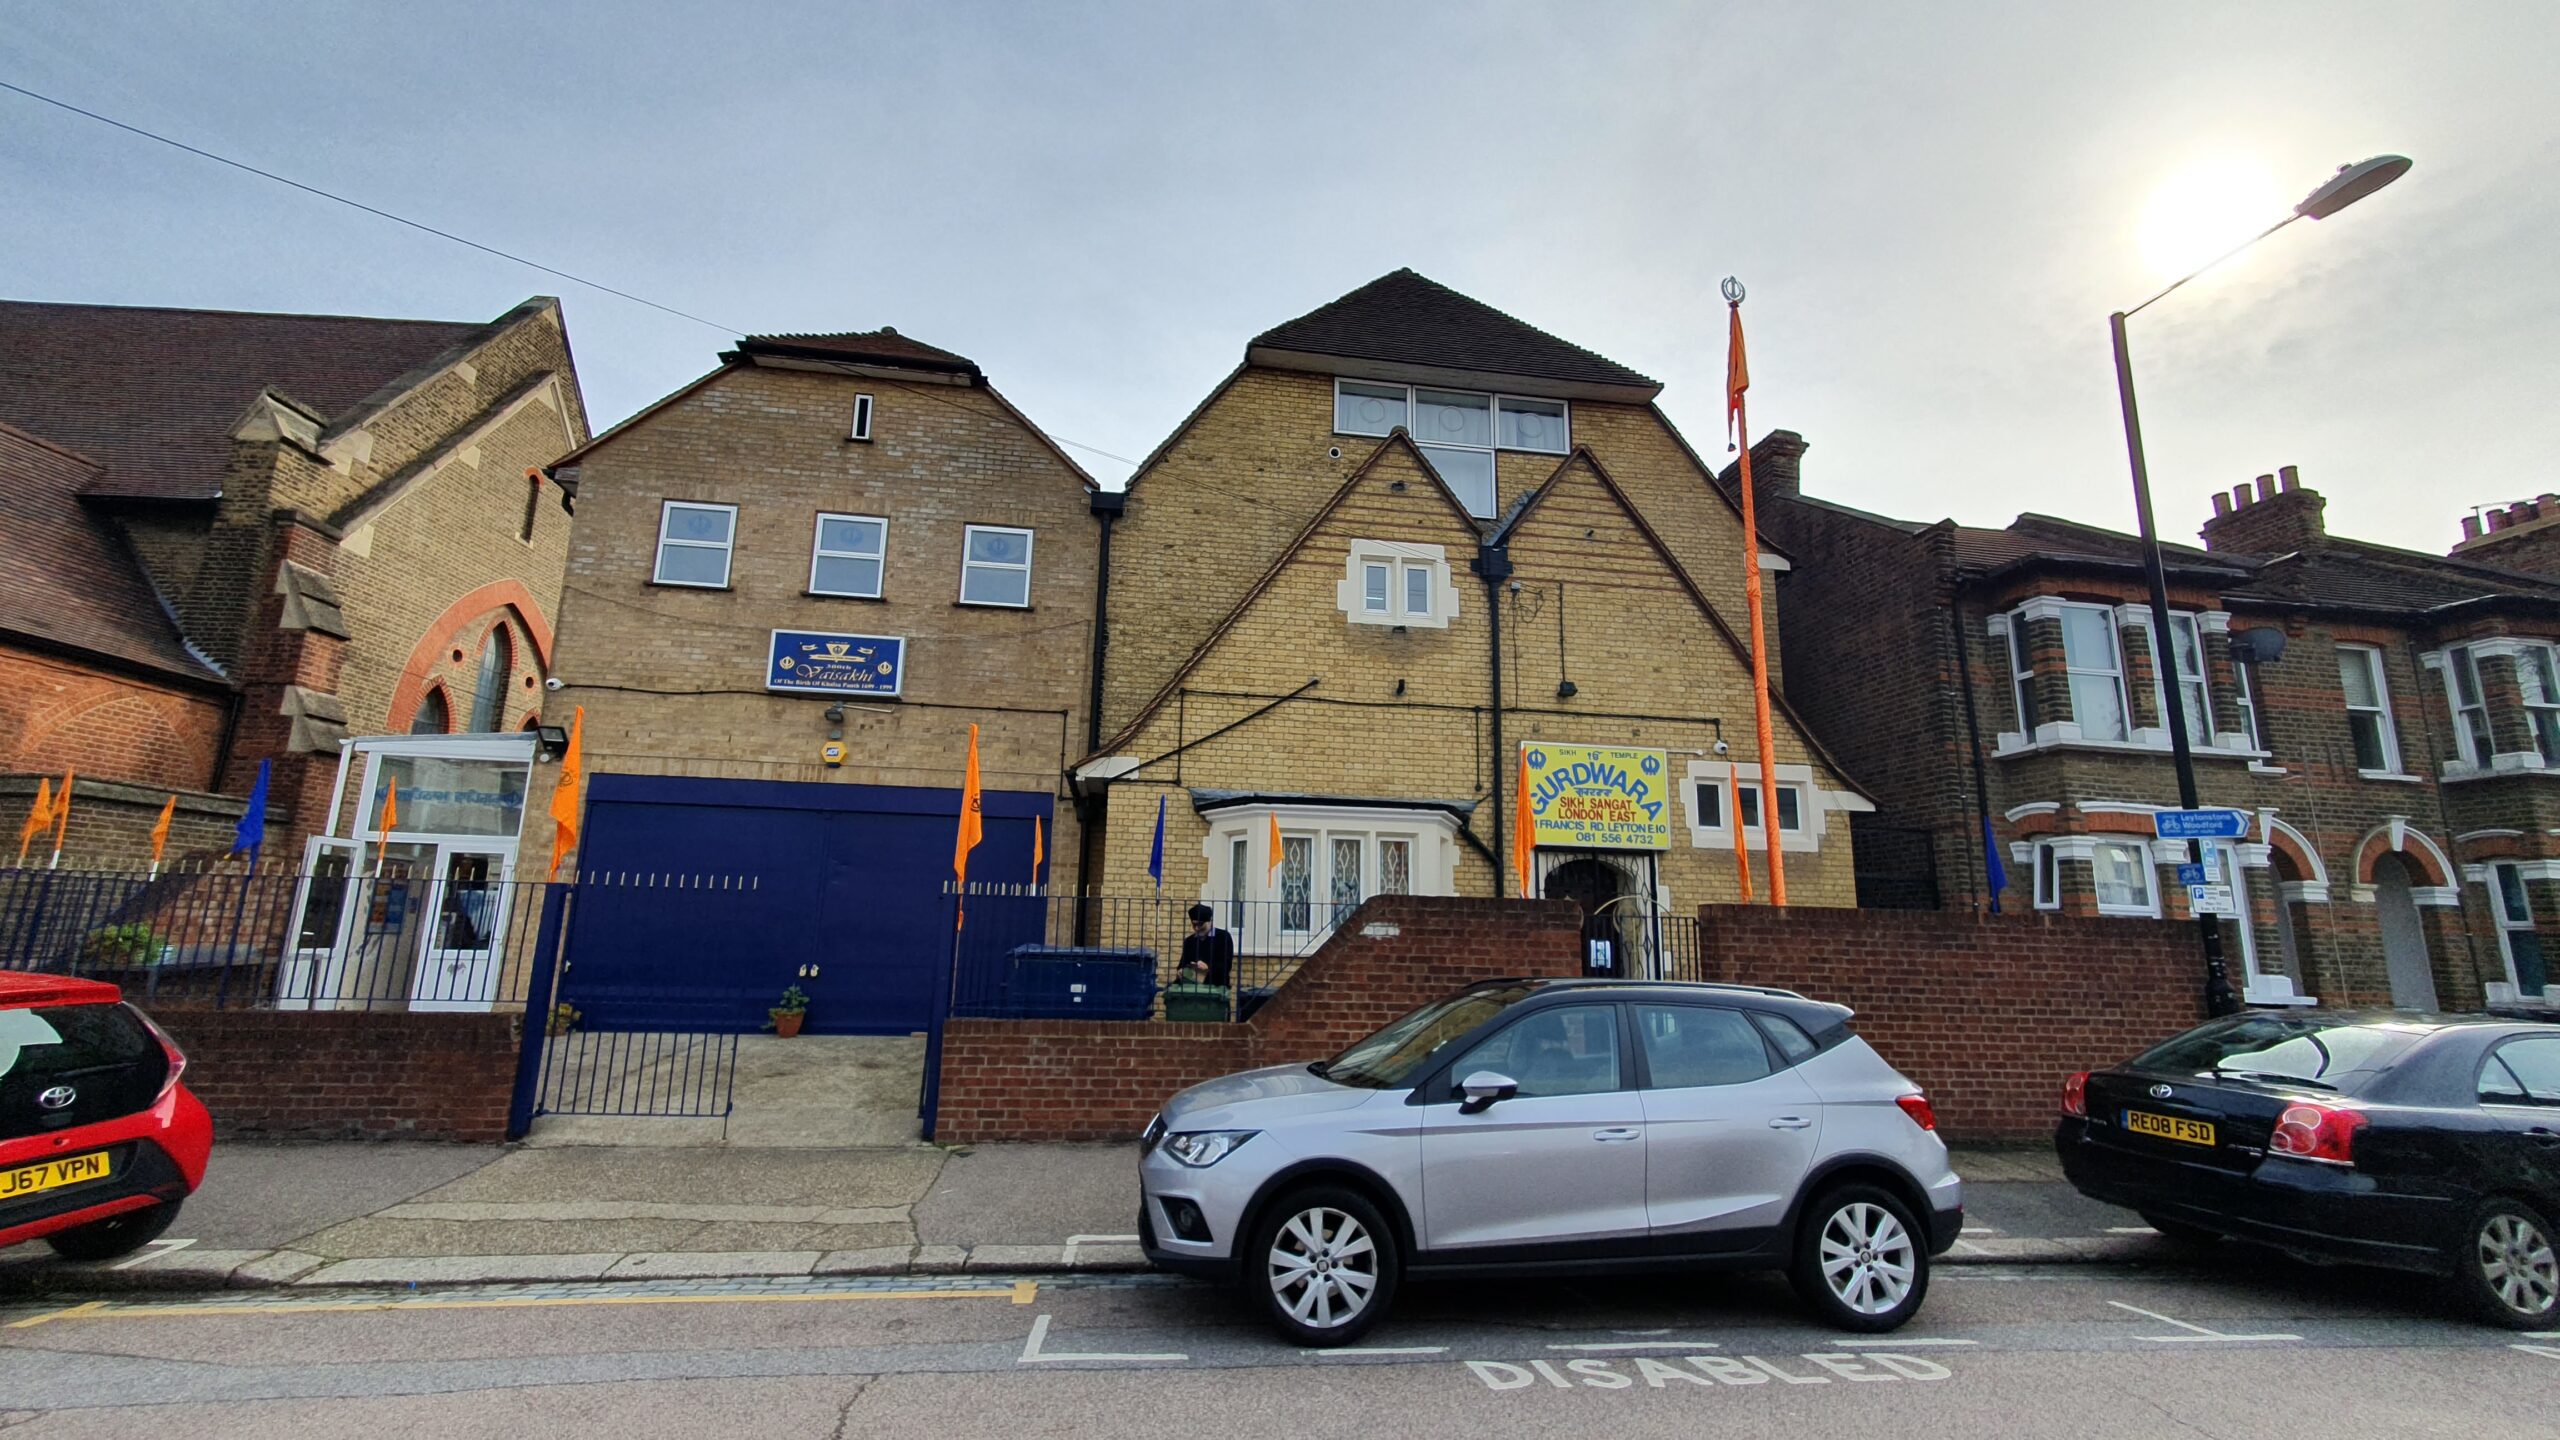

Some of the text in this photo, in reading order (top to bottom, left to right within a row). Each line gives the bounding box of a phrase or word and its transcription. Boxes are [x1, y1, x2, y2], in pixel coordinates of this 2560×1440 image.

[1530, 761, 1663, 822] GURDWARA
[1560, 797, 1632, 810] SIKH SANGAT
[1558, 808, 1637, 822] LONDON EAST
[1540, 819, 1585, 831] FRANCIS
[1608, 824, 1646, 833] LEYTON
[2182, 821, 2223, 829] Woodford
[1576, 832, 1653, 844] 081 556 4732
[2195, 888, 2202, 898] P
[2131, 1113, 2171, 1133] RE08
[2176, 1121, 2210, 1140] FSD
[2, 1156, 99, 1193] J67 VPN
[1465, 1353, 1951, 1390] DISABLED
